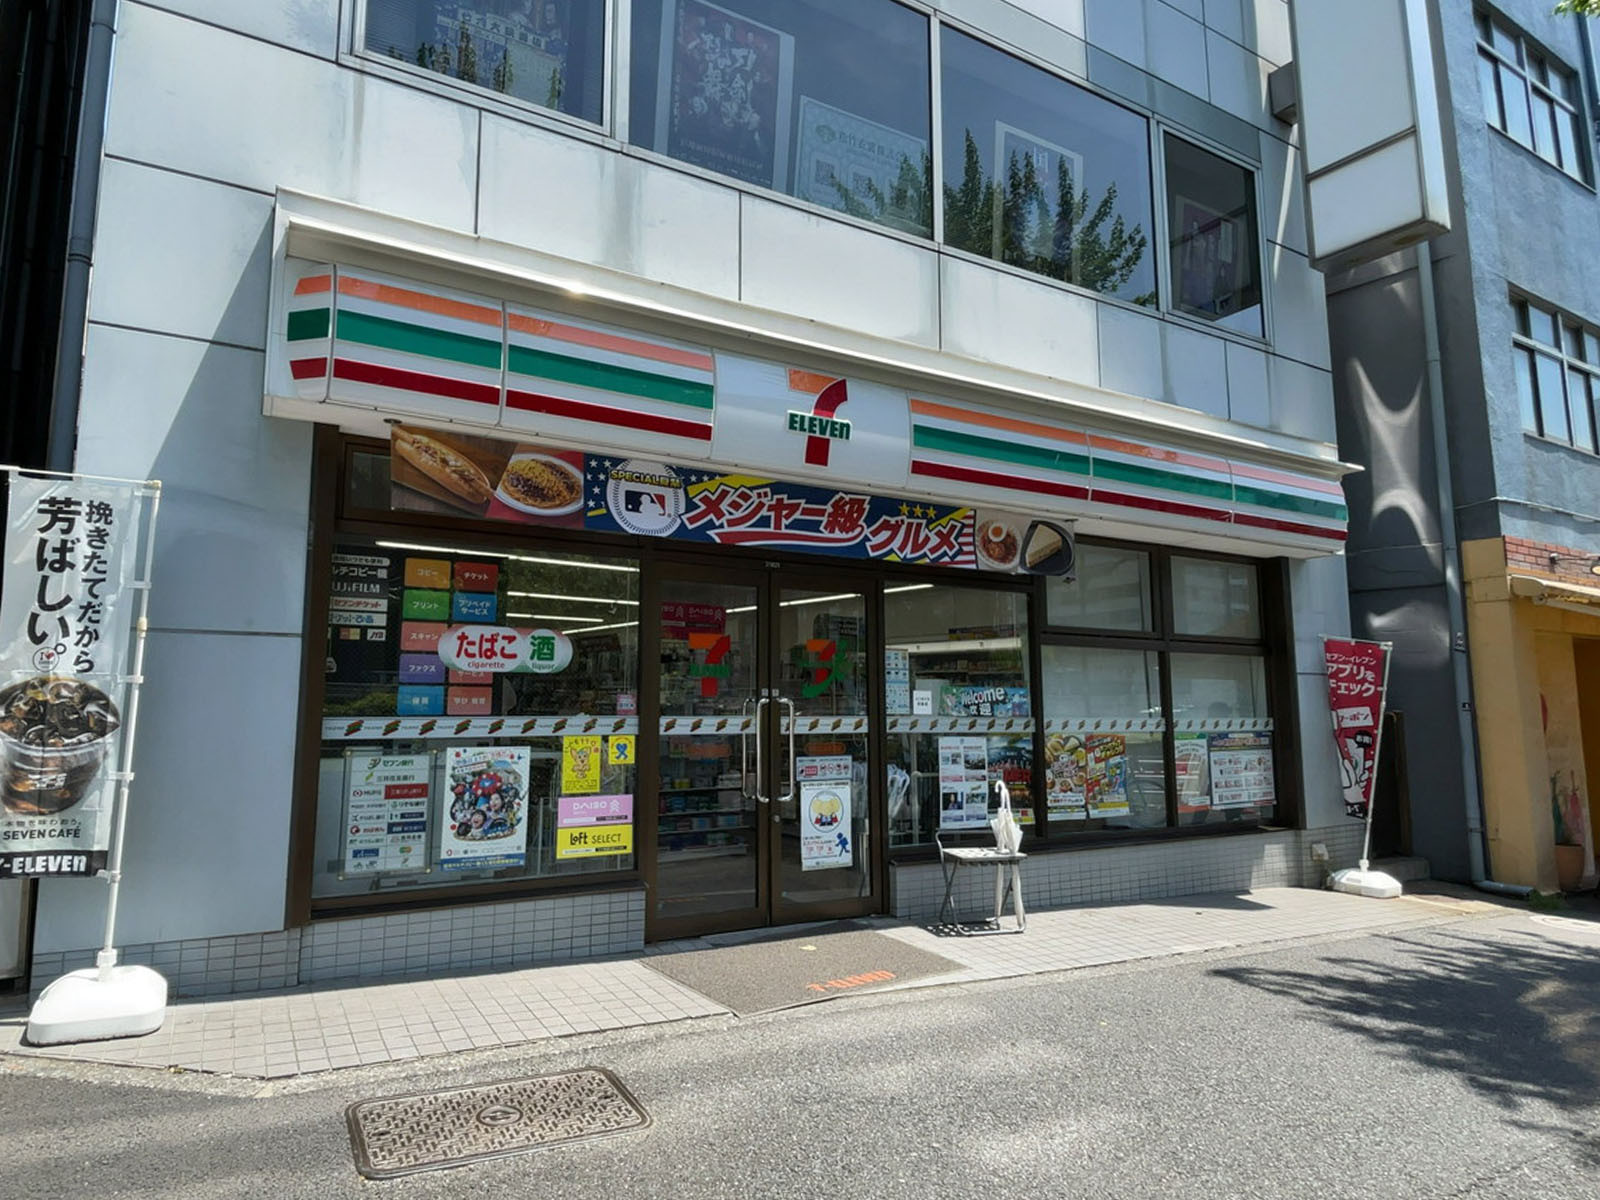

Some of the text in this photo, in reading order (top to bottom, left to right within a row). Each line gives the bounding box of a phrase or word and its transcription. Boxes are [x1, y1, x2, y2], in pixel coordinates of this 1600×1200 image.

[788, 368, 848, 466] 7
[683, 486, 962, 556] メジャー級 グルメ
[27, 497, 82, 656] 芳ばしい。
[73, 500, 113, 673] 挽きたてだから
[463, 572, 488, 581] チケット
[456, 632, 518, 660] たばこ
[530, 635, 556, 662] 酒
[467, 661, 505, 670] cigarette
[1326, 663, 1376, 681] アプリを
[960, 686, 1005, 706] Welcome
[3, 825, 81, 840] SEVEN CAFÉ
[591, 833, 621, 845] SELECT
